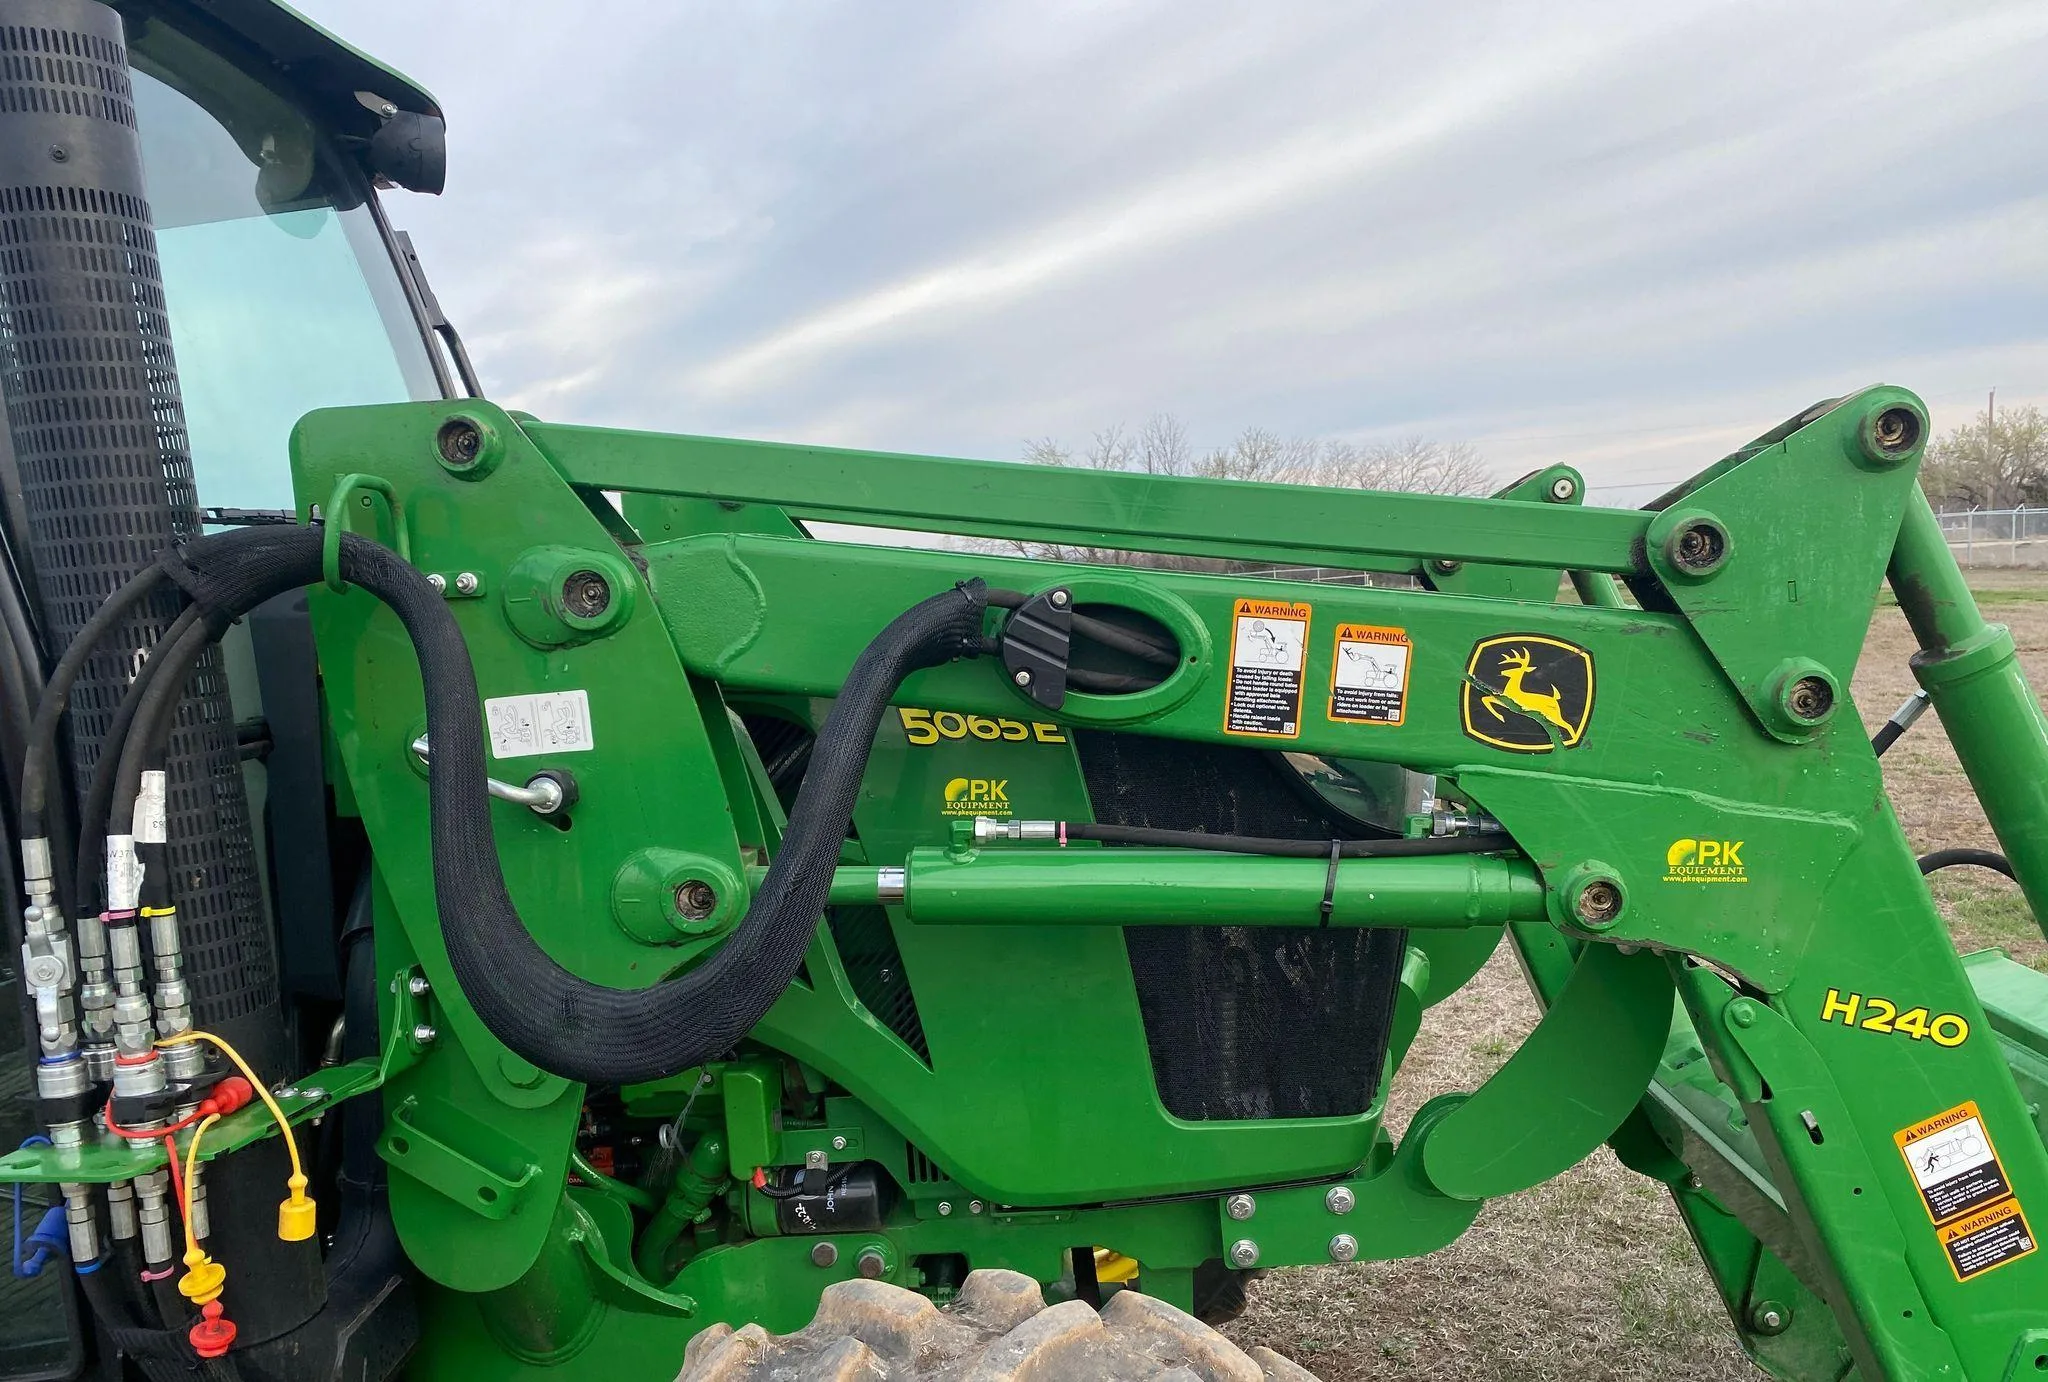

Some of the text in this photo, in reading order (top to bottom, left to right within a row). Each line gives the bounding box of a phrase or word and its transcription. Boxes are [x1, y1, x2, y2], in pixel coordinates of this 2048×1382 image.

[1255, 606, 1306, 617] WARNING
[1356, 631, 1408, 642] WARNING
[946, 802, 1010, 810] EQUIPMENT
[941, 809, 1013, 817] www.pkequipment.com
[1669, 866, 1745, 876] EQUIPMENT
[1662, 875, 1748, 884] www.pkequipment.com
[1821, 988, 1970, 1048] H240
[1917, 1109, 1968, 1136] WARNING
[825, 1185, 835, 1212] JOHN
[1961, 1206, 2012, 1233] WARNING
